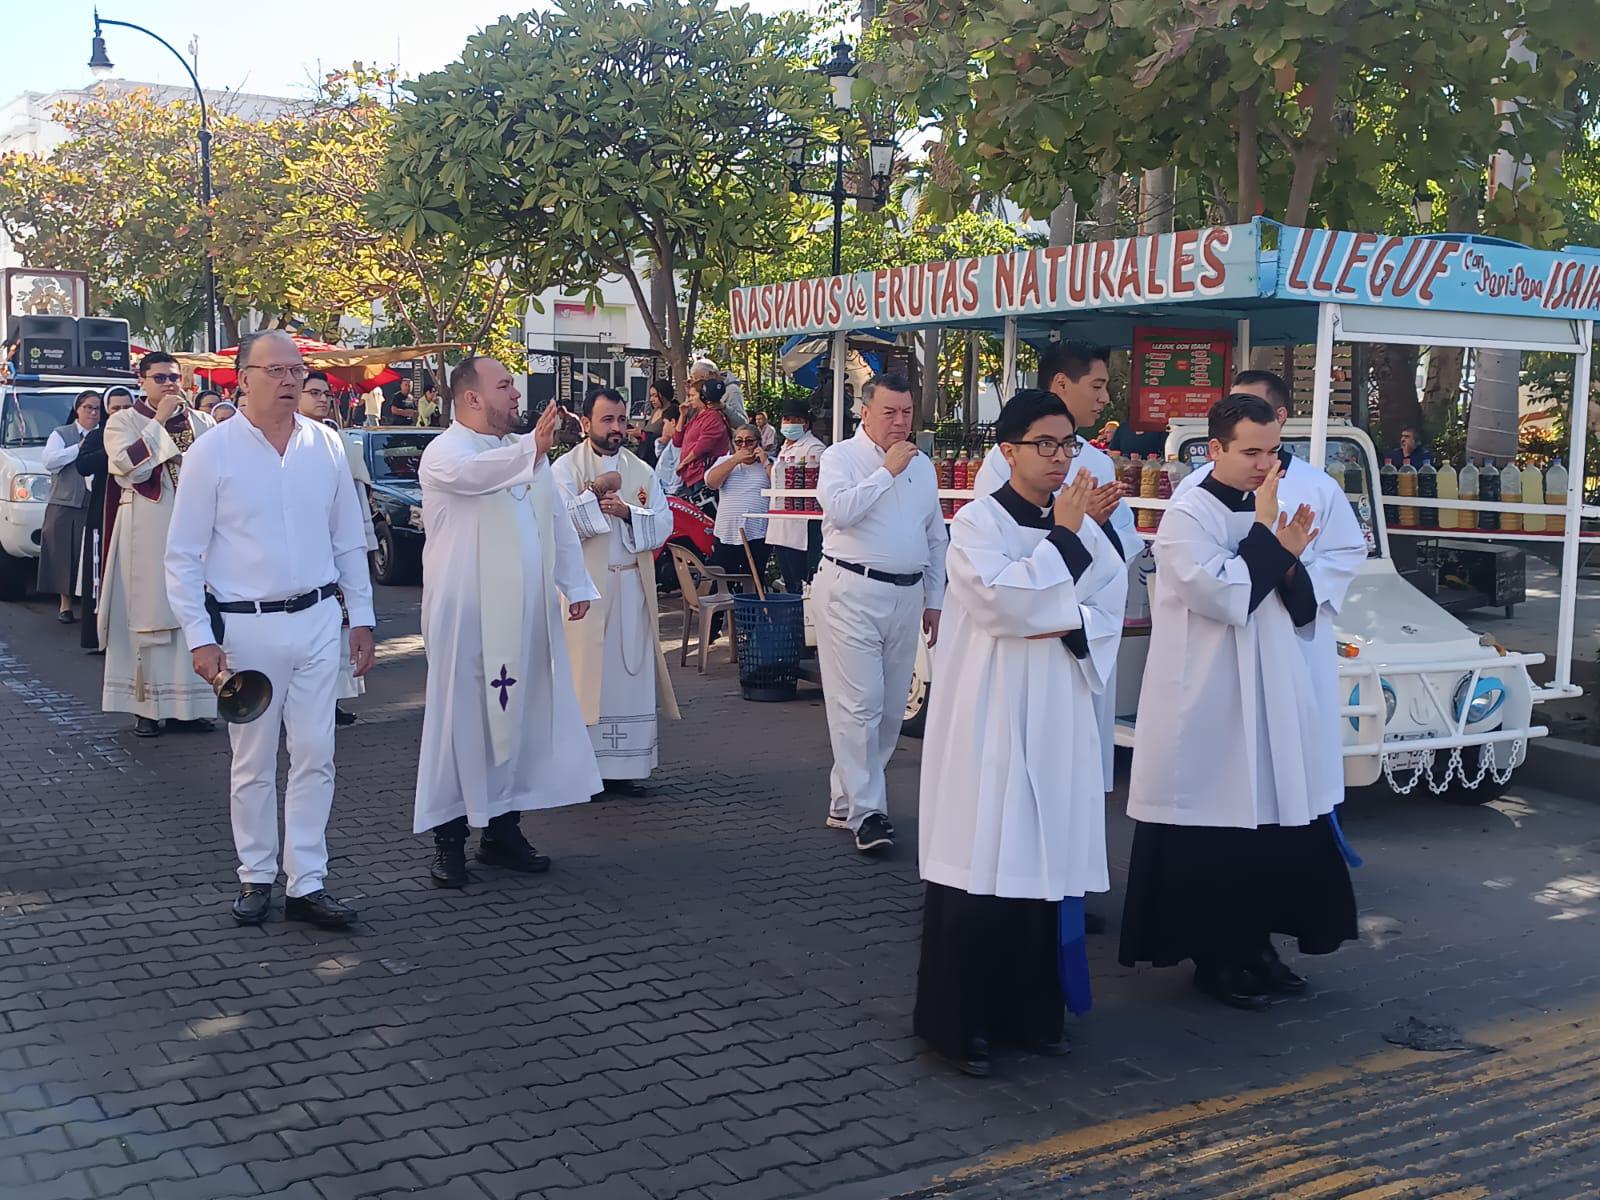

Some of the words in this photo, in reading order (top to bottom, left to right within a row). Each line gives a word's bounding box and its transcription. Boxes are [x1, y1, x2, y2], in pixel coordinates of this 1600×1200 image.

[730, 275, 843, 337] RASPADOS
[873, 257, 981, 320] FRUTAS
[995, 228, 1232, 310] NATURALES
[1287, 228, 1462, 303] LLEGUE
